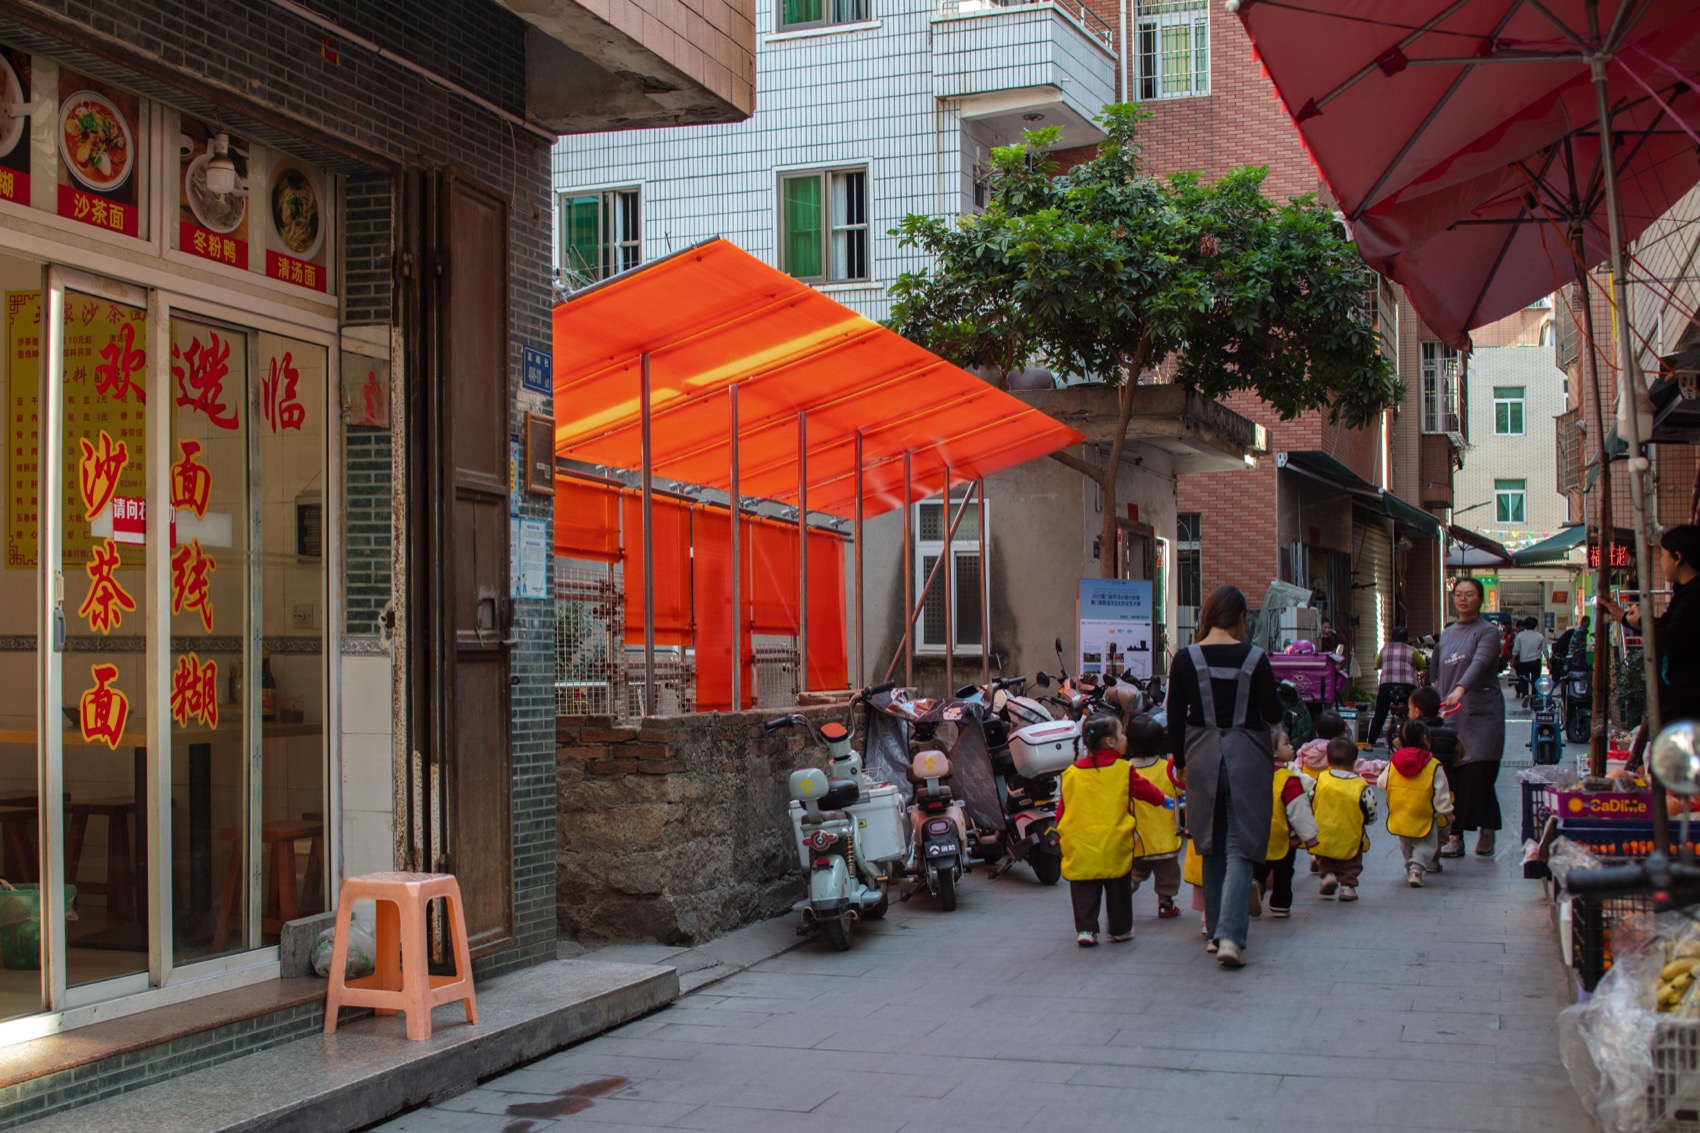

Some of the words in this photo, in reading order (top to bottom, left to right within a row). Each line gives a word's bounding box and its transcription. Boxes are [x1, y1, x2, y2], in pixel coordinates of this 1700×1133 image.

[74, 193, 124, 230] 沙茶面
[194, 230, 236, 264] 冬粉鸭
[278, 256, 315, 287] 清汤面
[79, 430, 136, 750] 沙茶面
